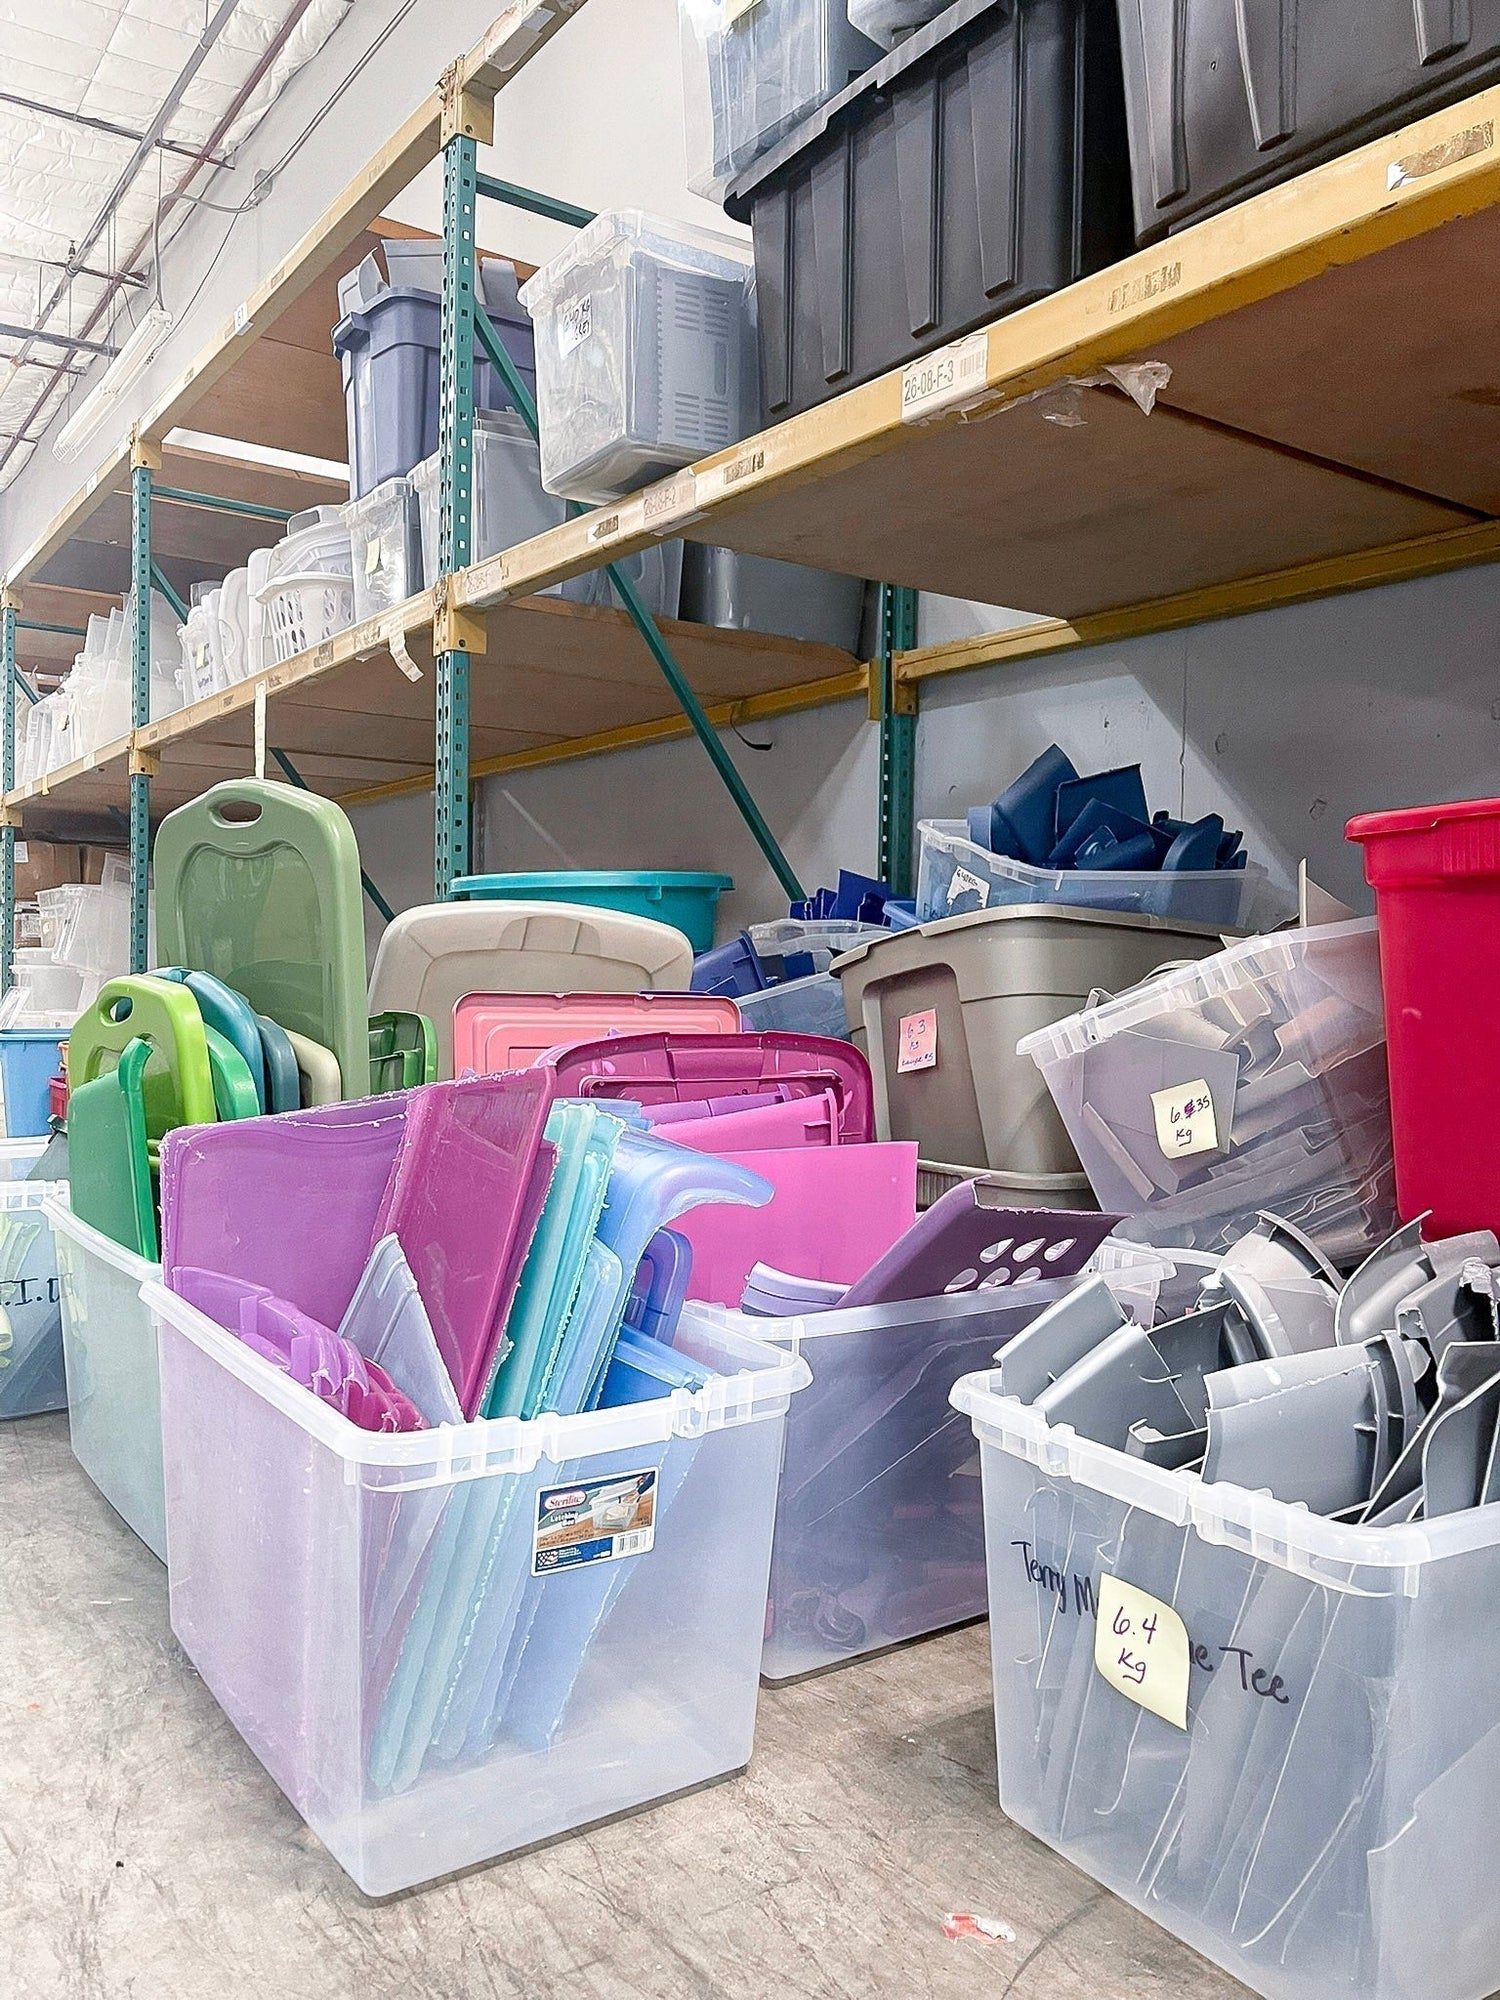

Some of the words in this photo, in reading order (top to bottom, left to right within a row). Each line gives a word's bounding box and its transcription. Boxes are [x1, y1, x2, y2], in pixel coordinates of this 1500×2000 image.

[904, 359, 954, 402] 26-08-F-3
[548, 1494, 583, 1508] Sterilite
[1011, 1541, 1066, 1614] Terry
[1218, 1646, 1290, 1704] Tee
[1112, 1606, 1157, 1644] 6.4
